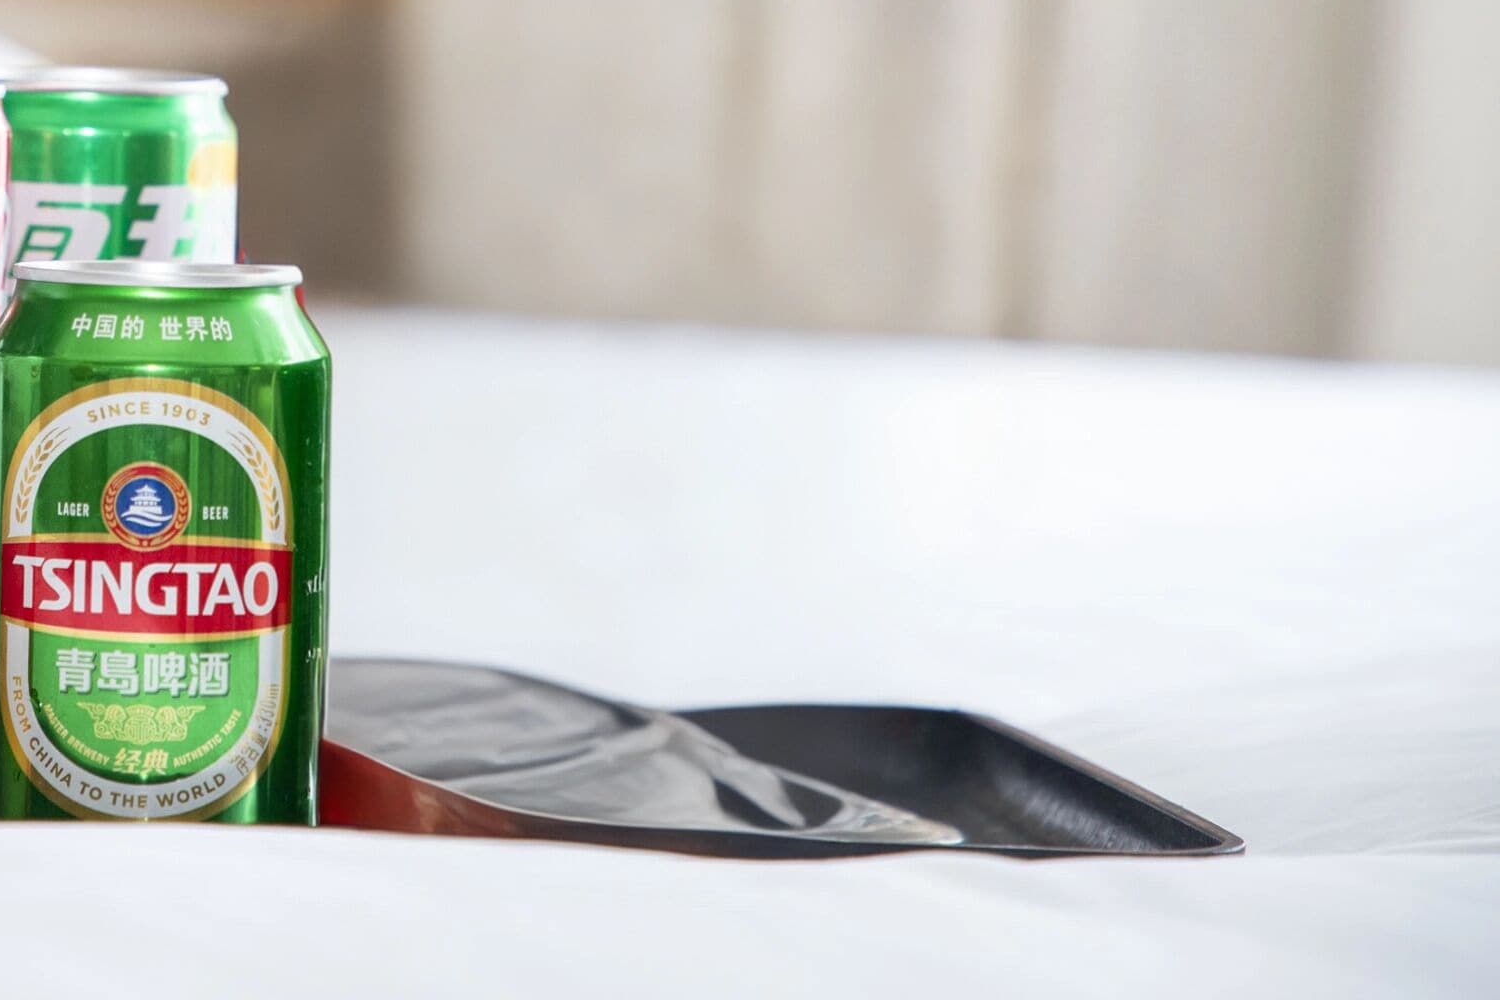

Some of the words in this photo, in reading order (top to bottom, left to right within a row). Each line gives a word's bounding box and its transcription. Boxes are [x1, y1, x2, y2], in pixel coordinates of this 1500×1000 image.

[71, 313, 144, 340] 中国的
[159, 316, 233, 342] 世界的
[87, 402, 150, 424] SINCE
[161, 403, 211, 427] 1903
[57, 501, 90, 517] LAGER
[202, 505, 229, 521] BEER
[12, 555, 279, 617] TSINGTAO
[55, 648, 231, 697] 青岛啤酒
[11, 676, 32, 734] FROM
[29, 736, 73, 788] CHINA
[80, 781, 103, 801] TO
[111, 792, 149, 809] THE
[156, 772, 227, 808] WORLD
[173, 733, 223, 768] AUTHENTIC
[220, 708, 242, 736] TASTE
[112, 747, 170, 776] 经典
